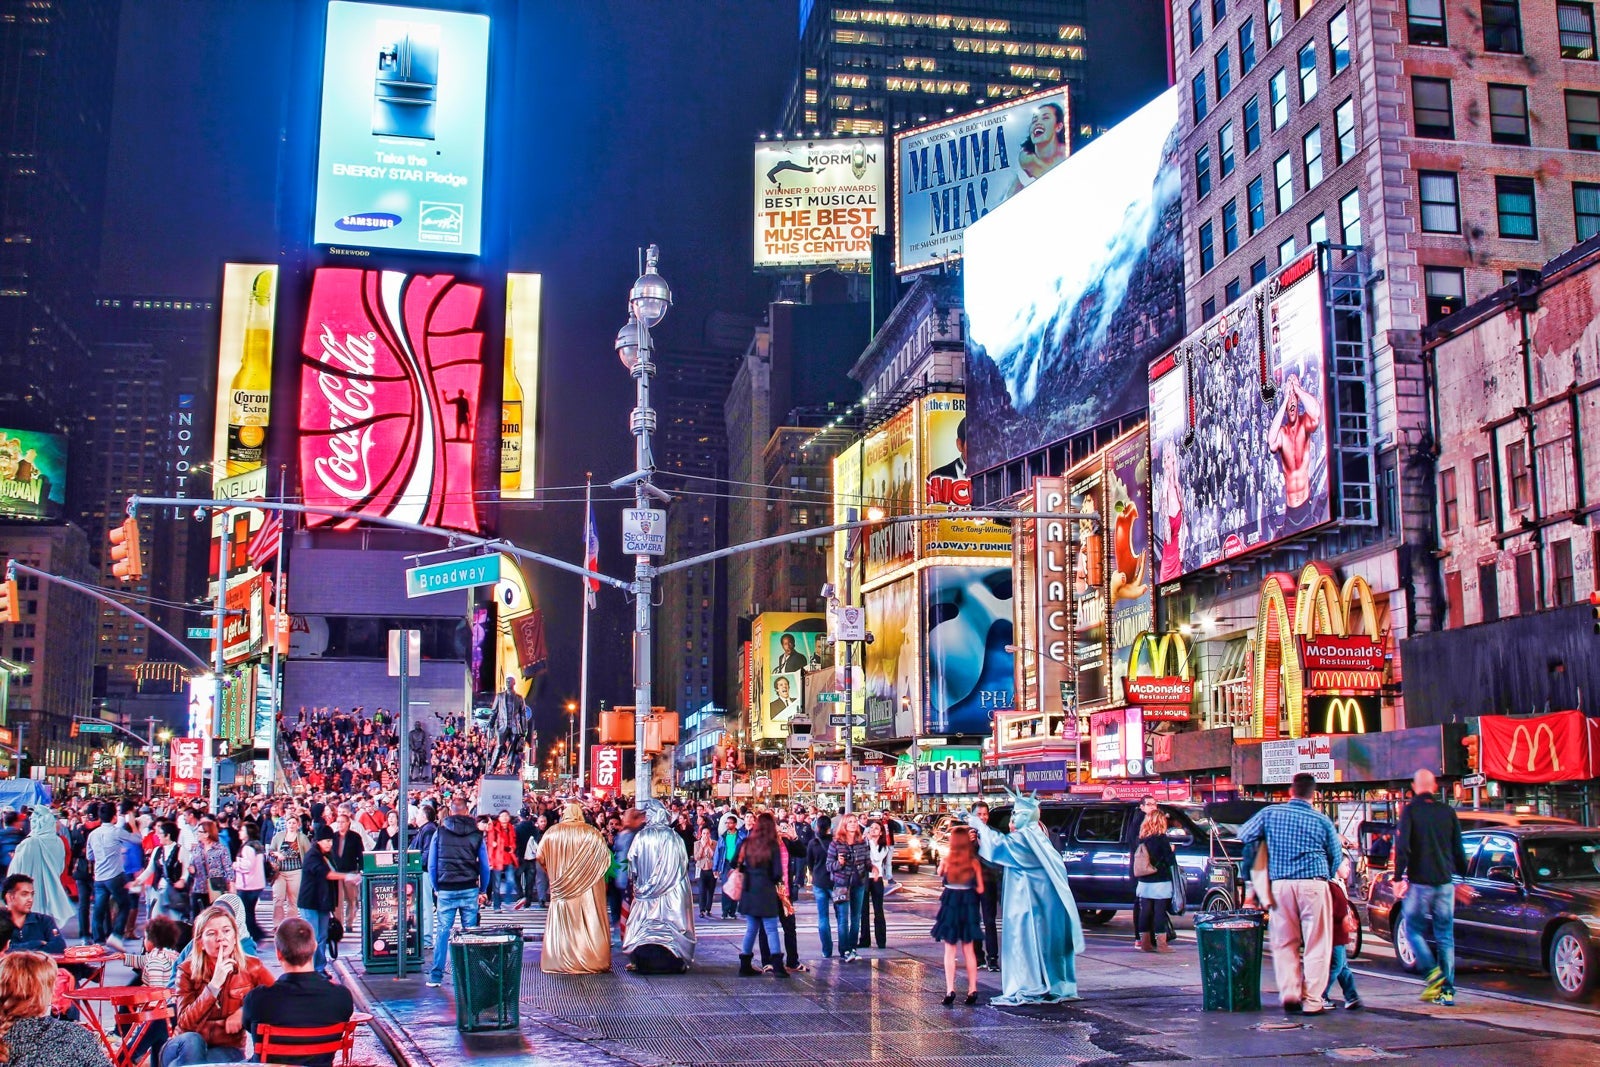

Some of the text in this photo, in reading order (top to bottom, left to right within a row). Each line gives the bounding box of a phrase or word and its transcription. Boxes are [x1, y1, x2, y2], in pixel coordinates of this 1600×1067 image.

[376, 151, 427, 167] Take the
[907, 125, 1010, 194] MAMMA
[332, 163, 468, 187] ENERGY STAR Pledge
[765, 187, 802, 196] WINNER
[765, 195, 876, 209] BEST MUSICAL
[930, 177, 989, 236] MIA!
[343, 216, 394, 228] SAMSUNG
[817, 208, 876, 226] BEST
[765, 227, 847, 243] MUSICAL
[765, 242, 799, 255] THIS
[910, 243, 920, 251] THE
[920, 239, 939, 250] SMASH
[939, 236, 949, 245] HIT
[243, 404, 267, 413] Extra
[314, 322, 375, 500] Coca-Cola
[952, 399, 966, 411] BR
[174, 413, 193, 520] NOVOTEL
[631, 512, 660, 521] NYPD
[624, 532, 664, 542] SECURITY
[965, 526, 1012, 535] Tony-Winning
[627, 541, 662, 551] CAMERA
[420, 564, 486, 589] Broadway
[1048, 492, 1065, 661] PALACE
[1306, 645, 1382, 658] McDonald's
[1319, 657, 1370, 667] Restaurant
[1129, 684, 1191, 695] McDonald's
[179, 741, 199, 779] tkts
[598, 749, 617, 785] tkts
[1026, 770, 1064, 782] MONEY EXCHANGE
